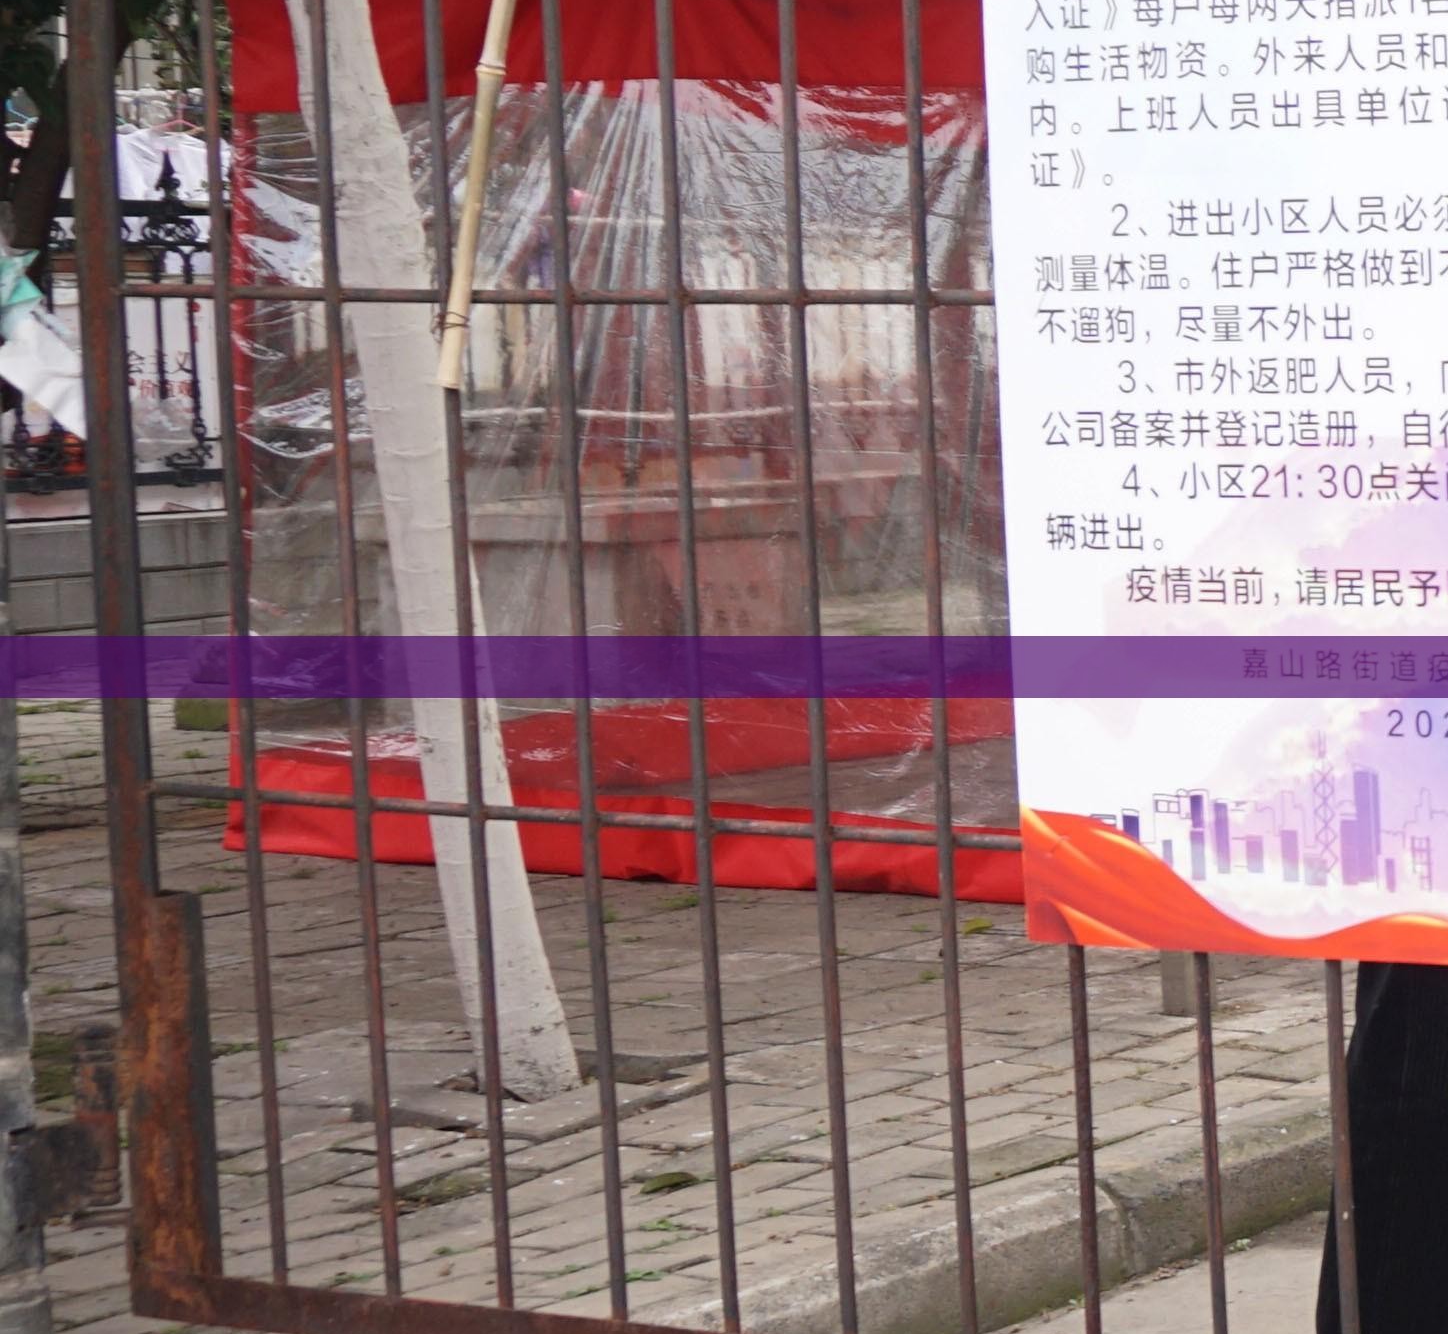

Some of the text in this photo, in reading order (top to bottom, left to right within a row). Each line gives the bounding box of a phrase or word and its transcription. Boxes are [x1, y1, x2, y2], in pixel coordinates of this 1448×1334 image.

[1030, 149, 1117, 192] 证》。
[1036, 305, 1376, 345] 不遛狗，尽量不外出。
[1046, 511, 1167, 553] 辆进出。
